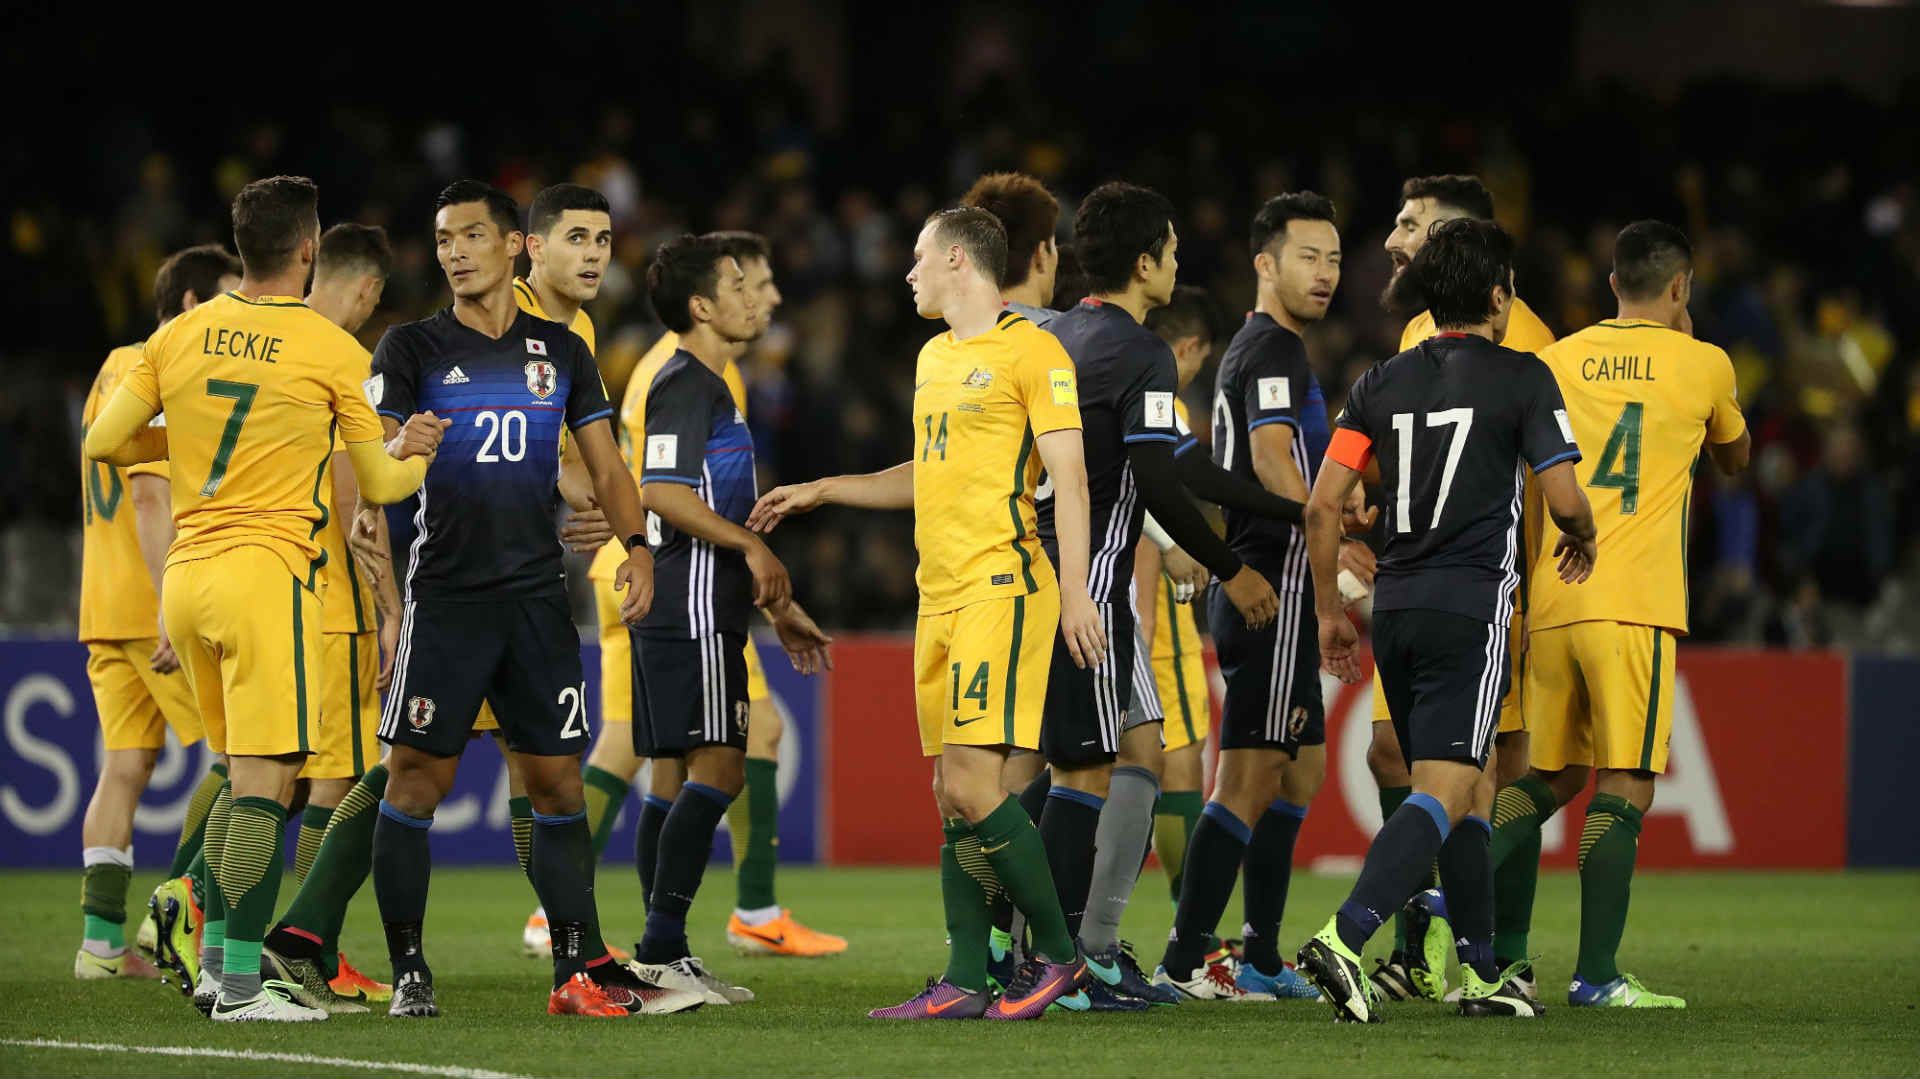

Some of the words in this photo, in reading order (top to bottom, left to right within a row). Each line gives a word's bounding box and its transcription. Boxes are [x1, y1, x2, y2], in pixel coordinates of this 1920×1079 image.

[203, 327, 283, 364] LECKIE
[1582, 355, 1656, 381] CAHILL
[200, 378, 260, 497] 7
[474, 410, 527, 463] 20
[922, 411, 949, 462] 14
[1586, 402, 1644, 515] 4
[1391, 407, 1474, 533] 17
[952, 661, 990, 711] 14
